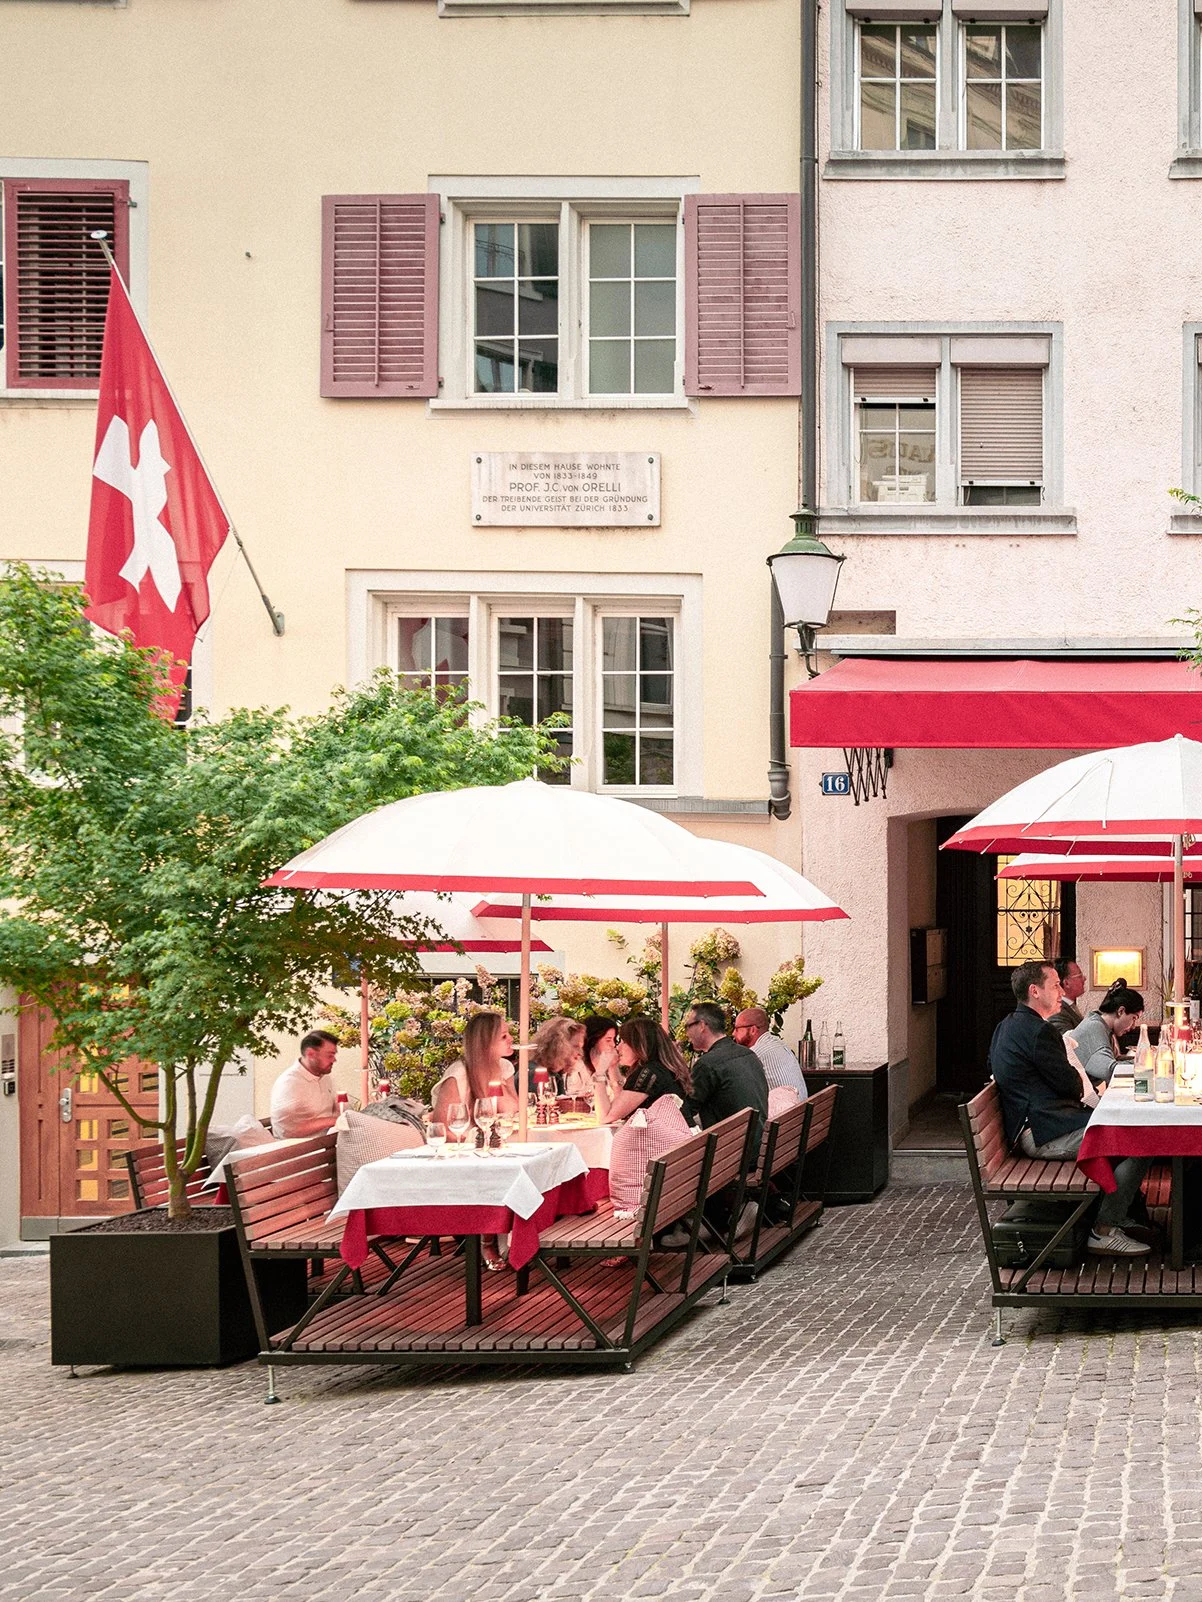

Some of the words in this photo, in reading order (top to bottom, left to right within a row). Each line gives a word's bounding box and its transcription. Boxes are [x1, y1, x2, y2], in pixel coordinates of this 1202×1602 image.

[509, 463, 518, 471] IN
[520, 463, 551, 471] DIESEM
[553, 463, 582, 471] HAUSE
[586, 463, 621, 471] WOHNTE
[533, 472, 551, 480] VON
[553, 472, 598, 480] 1833-1849
[509, 482, 541, 493] PROF.
[581, 482, 621, 493] ORELLI
[482, 495, 498, 503] DER
[500, 495, 542, 503] TREIBENDE
[544, 495, 567, 503] GEIST
[569, 495, 582, 503] BEI
[584, 495, 600, 503] DER
[602, 494, 648, 503] GRÜNDUNG
[501, 504, 517, 512] DER
[519, 503, 571, 512] UNIVERSITÄT
[574, 503, 605, 512] ZÜRICH
[608, 504, 629, 512] 1833
[826, 775, 846, 792] 16
